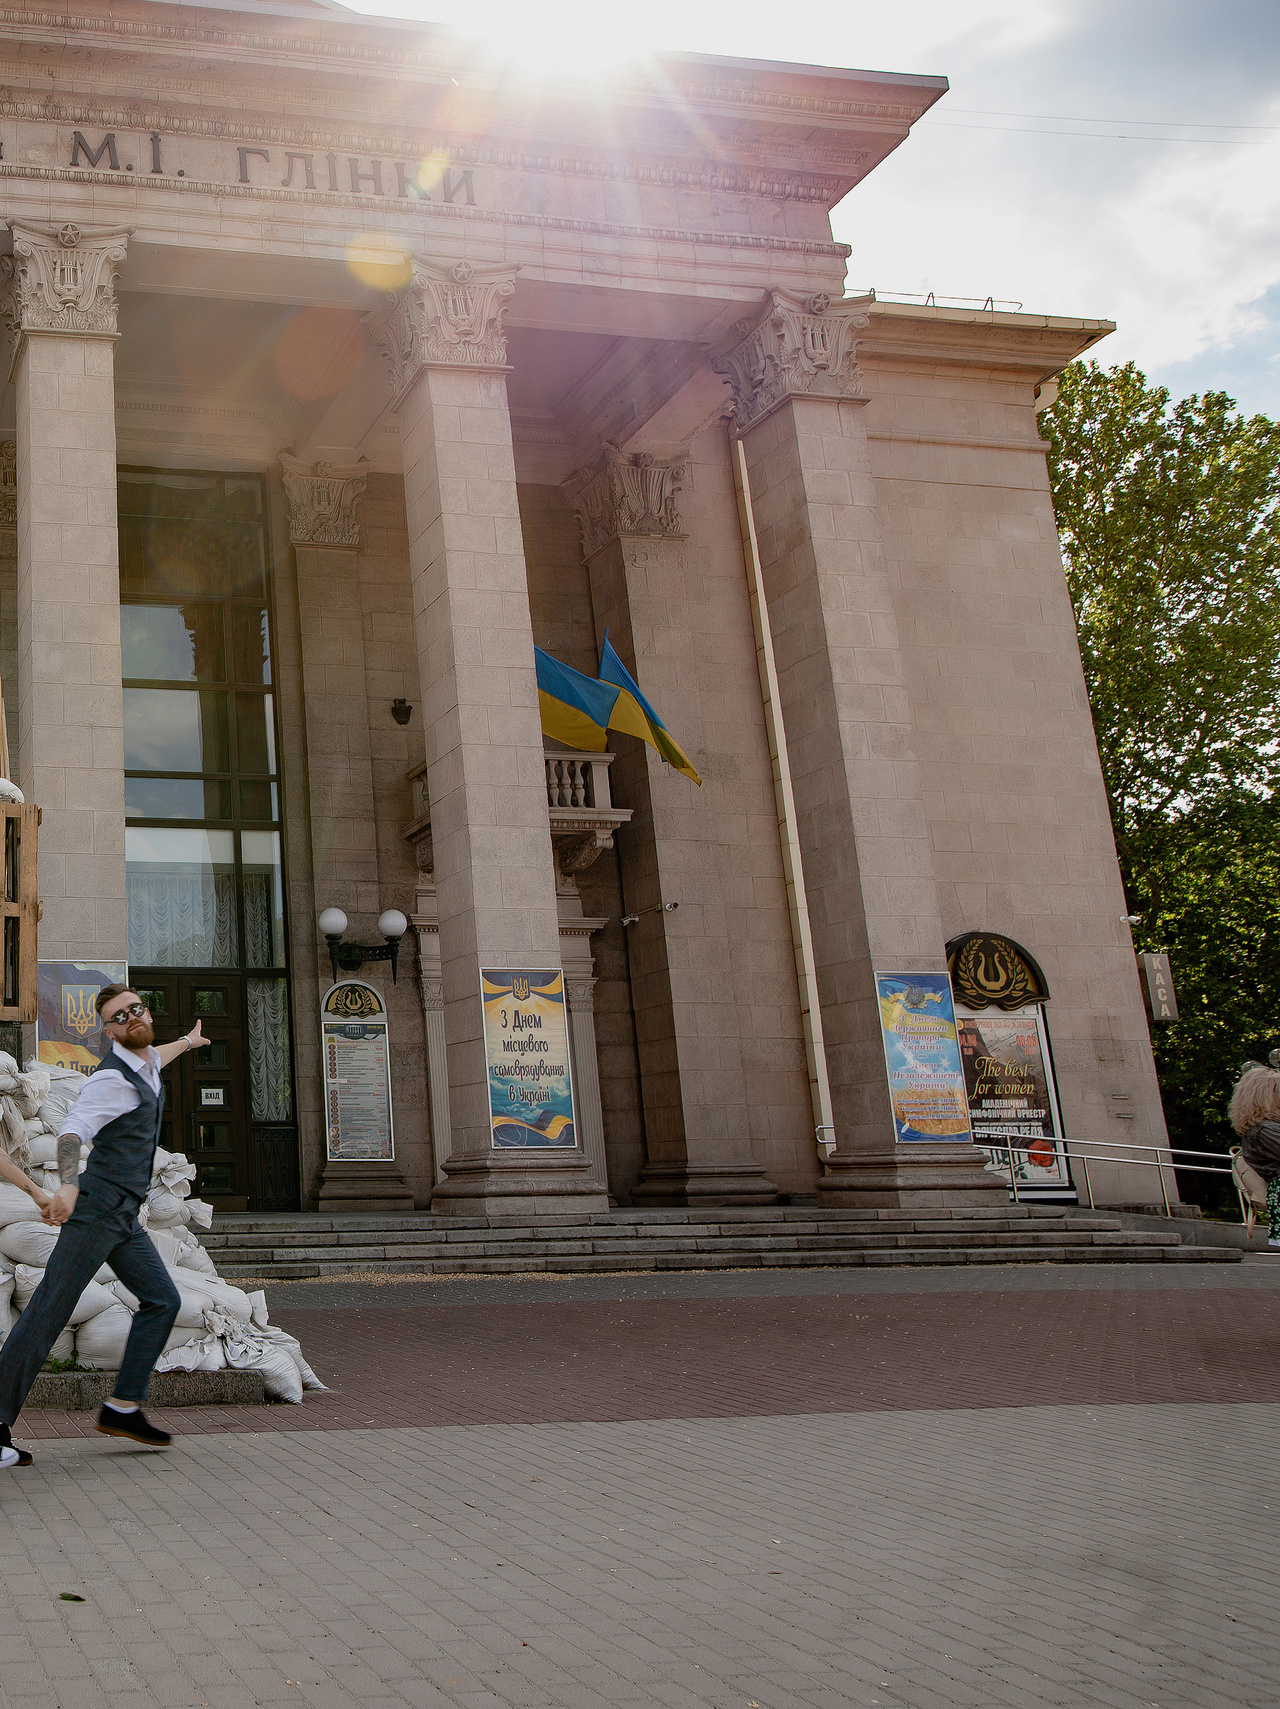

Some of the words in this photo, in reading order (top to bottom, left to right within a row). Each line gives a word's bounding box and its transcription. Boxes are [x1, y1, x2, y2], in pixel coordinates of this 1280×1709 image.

[236, 146, 477, 206] ГЛІНКИ
[1152, 957, 1171, 1017] КАСА
[500, 1009, 508, 1029] З
[512, 1009, 542, 1032] Днем
[910, 1014, 938, 1024] Днем
[892, 1024, 948, 1033] Державного
[901, 1033, 940, 1042] Прапора
[501, 1033, 549, 1056] місцевого
[903, 1043, 942, 1052] України
[494, 1059, 565, 1081] самоврядування
[911, 1061, 937, 1070] Днем
[975, 1056, 1001, 1077] The
[1004, 1056, 1034, 1077] best
[893, 1071, 959, 1080] Незалежності
[908, 1081, 949, 1090] України!
[968, 1075, 991, 1100] for
[994, 1083, 1035, 1095] women
[205, 1092, 220, 1101] ВХІД
[509, 1084, 516, 1102] в
[518, 1085, 551, 1106] Україні
[982, 1098, 1028, 1109] АКАДЕМІЧНИЙ
[1016, 1109, 1046, 1118] ОРКЕСТР
